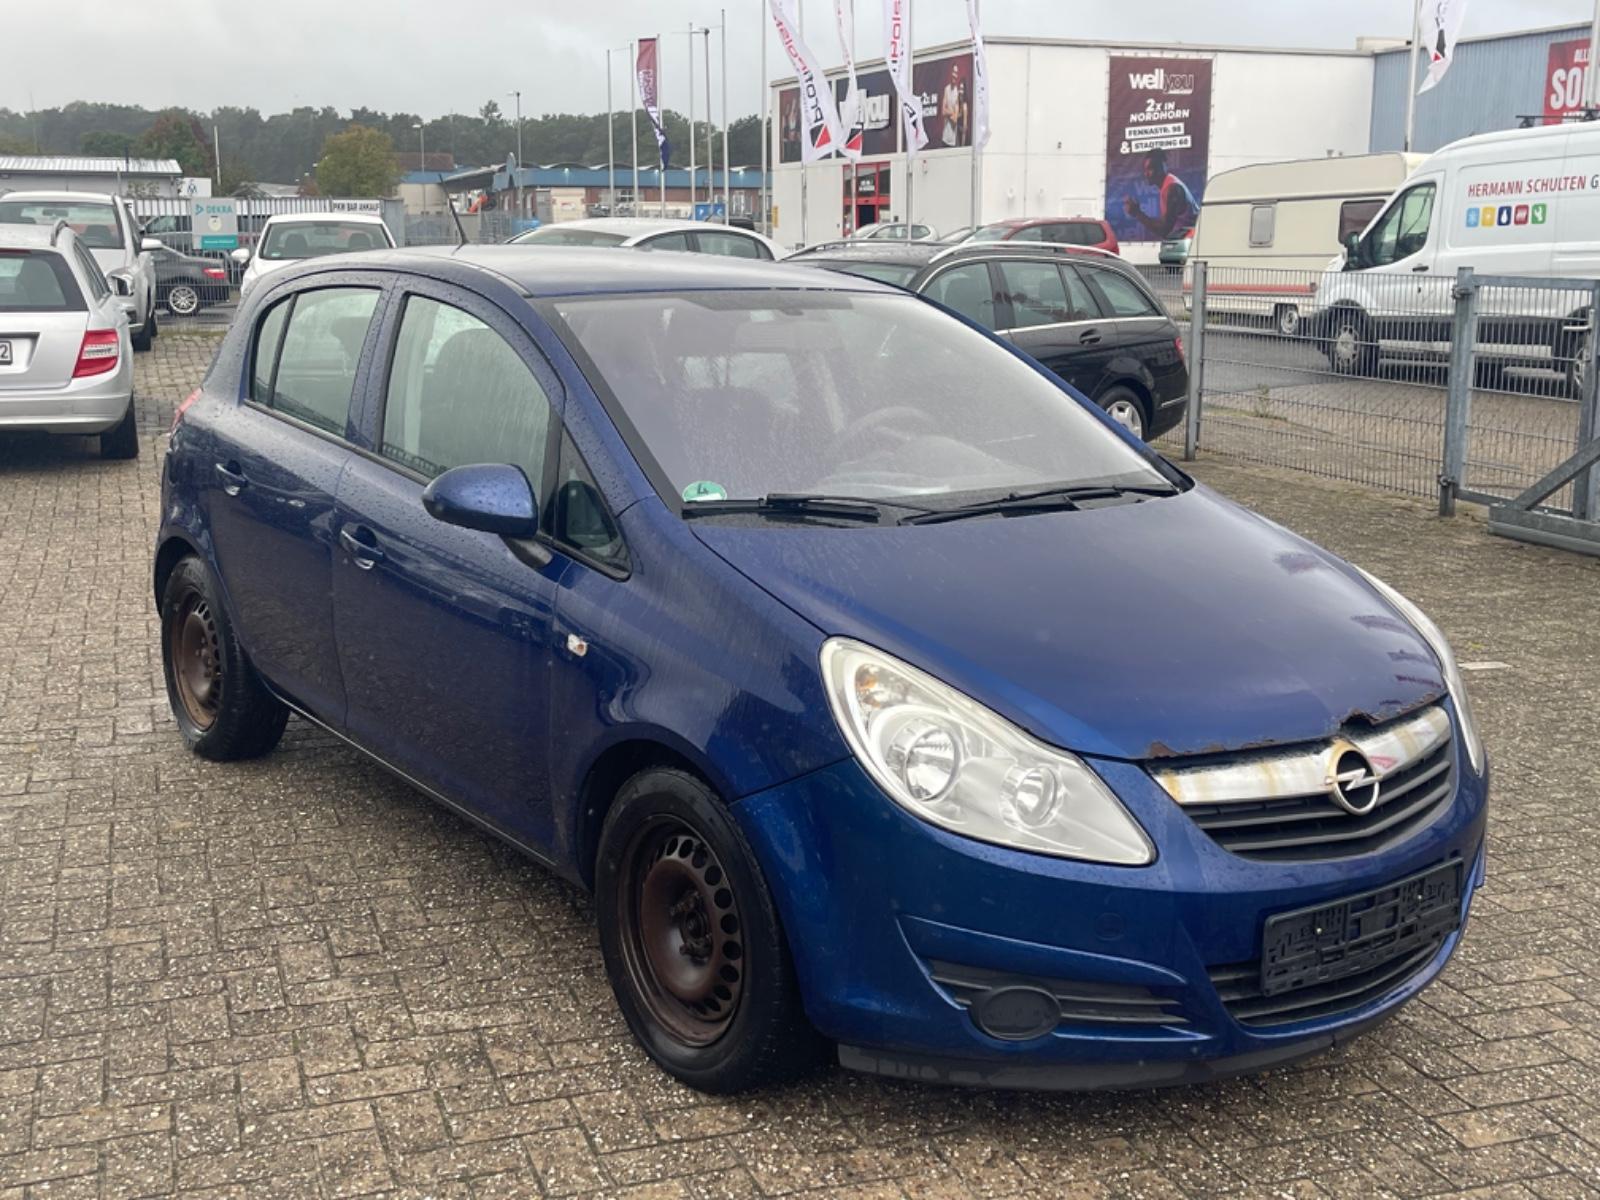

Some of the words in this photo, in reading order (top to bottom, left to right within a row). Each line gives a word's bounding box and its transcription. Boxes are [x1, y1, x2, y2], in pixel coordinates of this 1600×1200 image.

[1128, 68, 1194, 94] wellyou
[1164, 101, 1176, 110] IN
[1129, 109, 1190, 123] NORDHORN
[1120, 140, 1130, 154] &
[1467, 180, 1523, 197] HERMANN
[1526, 175, 1587, 193] SCHULTEN
[206, 205, 233, 214] DEKRA
